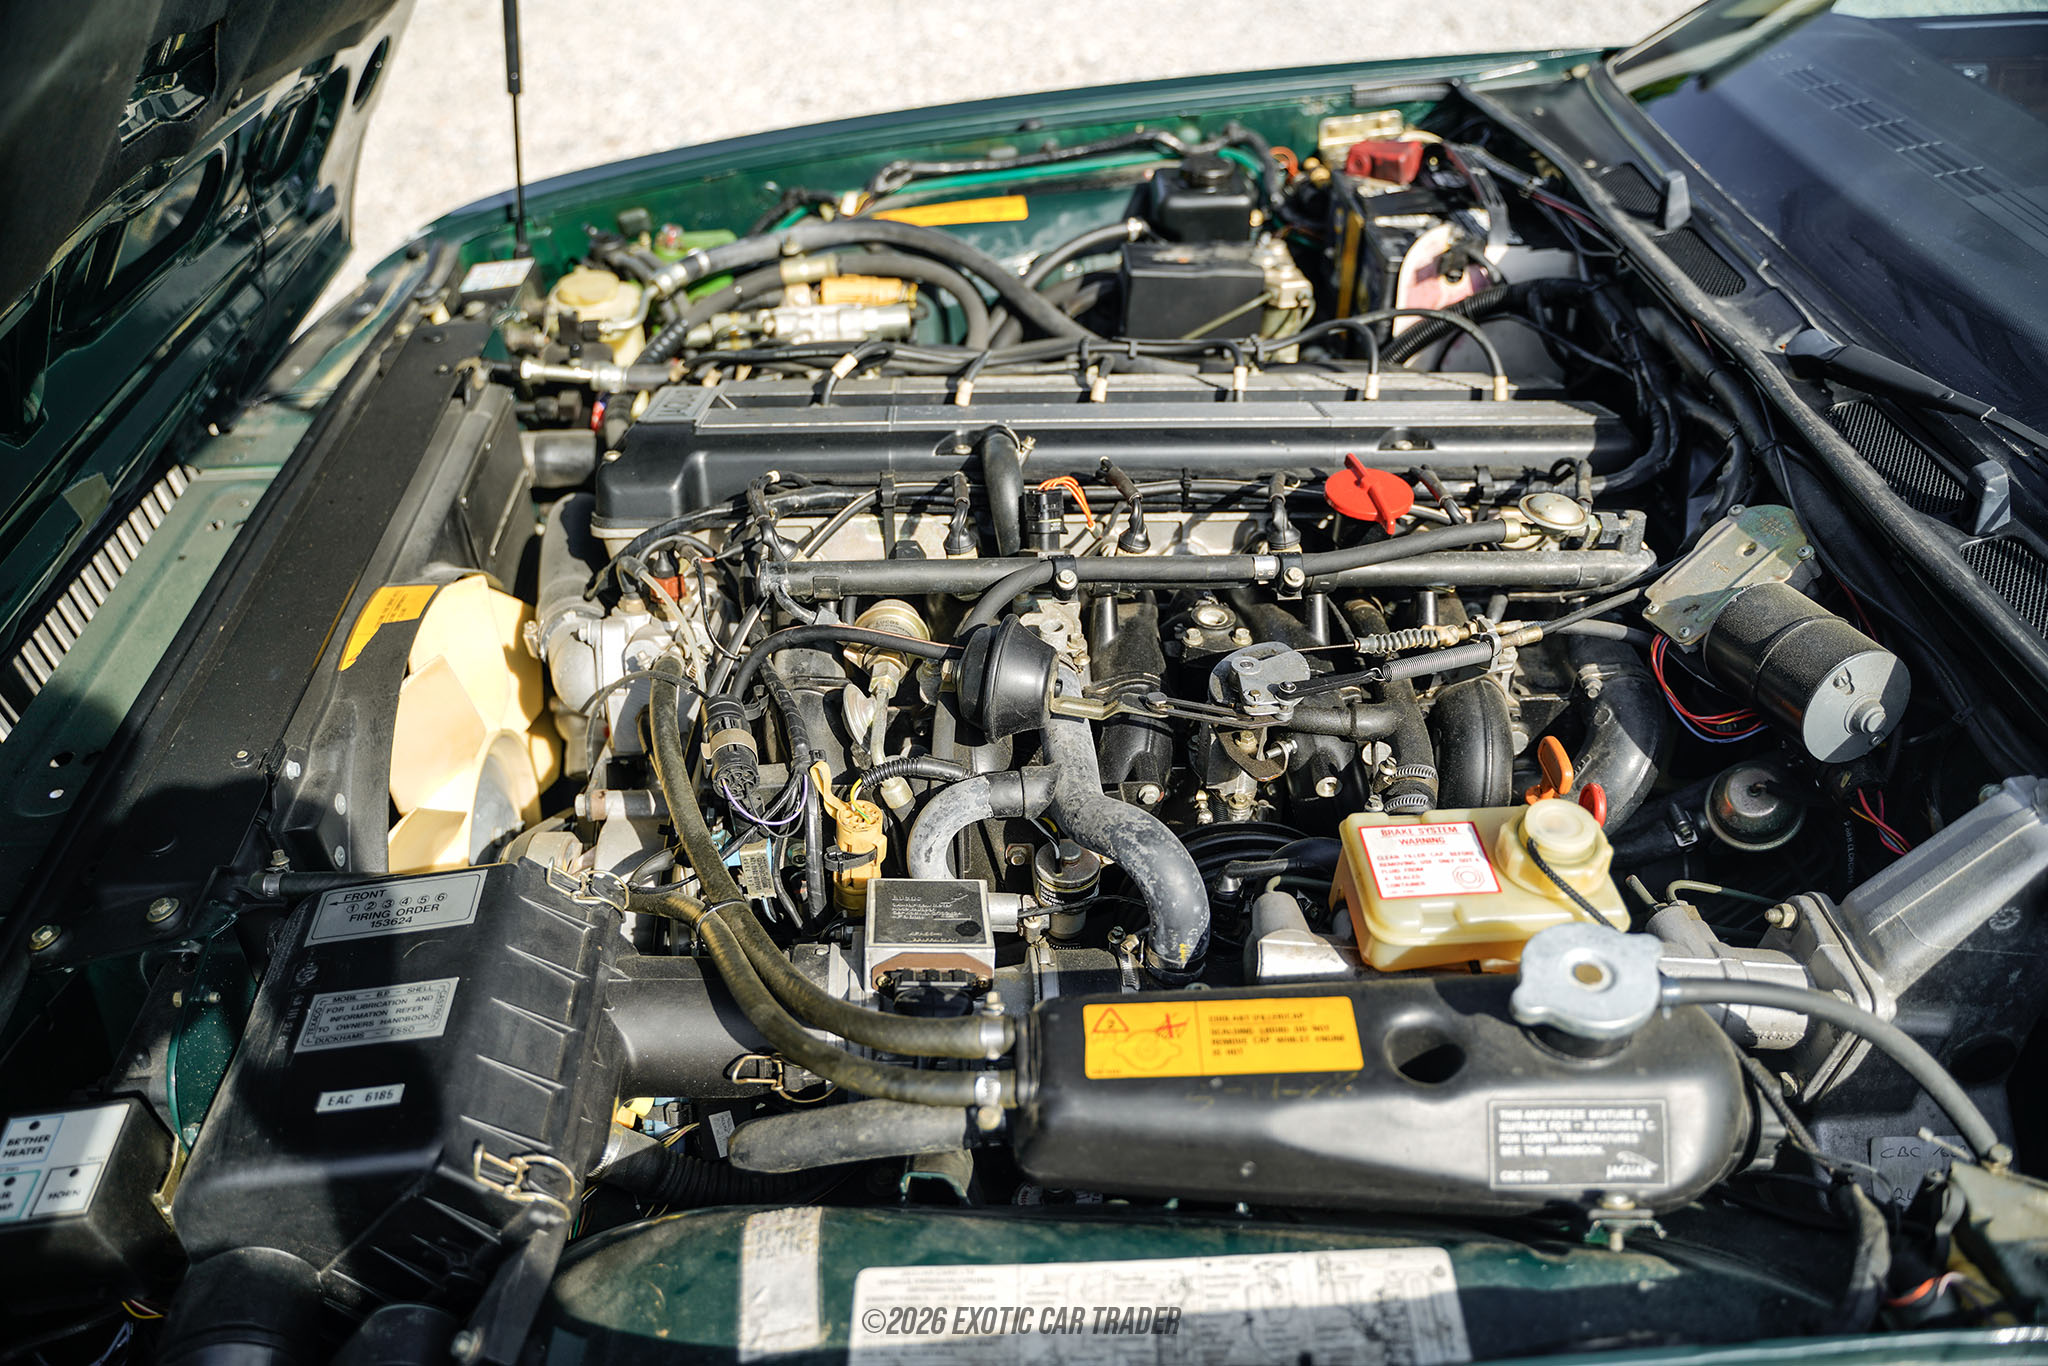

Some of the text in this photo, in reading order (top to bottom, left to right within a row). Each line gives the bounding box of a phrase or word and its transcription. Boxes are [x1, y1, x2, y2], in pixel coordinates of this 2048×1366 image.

[1381, 826, 1458, 837] BRAKE SYSTEM
[1399, 837, 1446, 845] WARNING
[344, 889, 388, 902] FRONT
[349, 904, 440, 922] FIRING ORDER
[370, 916, 413, 928] 153624
[407, 985, 433, 994] SHELL
[326, 994, 434, 1014] FOR LUBRICATION AND
[329, 1005, 424, 1023] INFORMATION REFER
[307, 1006, 323, 1038] TEXACO
[336, 1021, 374, 1031] OWNERS
[379, 1014, 430, 1025] HANDBOOK
[314, 1032, 366, 1044] DUCKHAMS
[390, 1026, 415, 1035] ESSO
[327, 1091, 394, 1106] EAC 6185
[1499, 1109, 1523, 1120] THIS
[1588, 1109, 1635, 1120] MIXTURE
[1499, 1120, 1547, 1132] SUITABLE
[1549, 1120, 1572, 1132] FOR
[1596, 1120, 1644, 1131] DEGREES
[1499, 1132, 1640, 1144] FOR LOWER TEMPERATURES
[3, 1146, 45, 1158] HEATER
[1499, 1144, 1521, 1157] SEE
[1524, 1144, 1544, 1156] THE
[1880, 1146, 1922, 1159] CBC
[1606, 1164, 1654, 1180] JAGUAR
